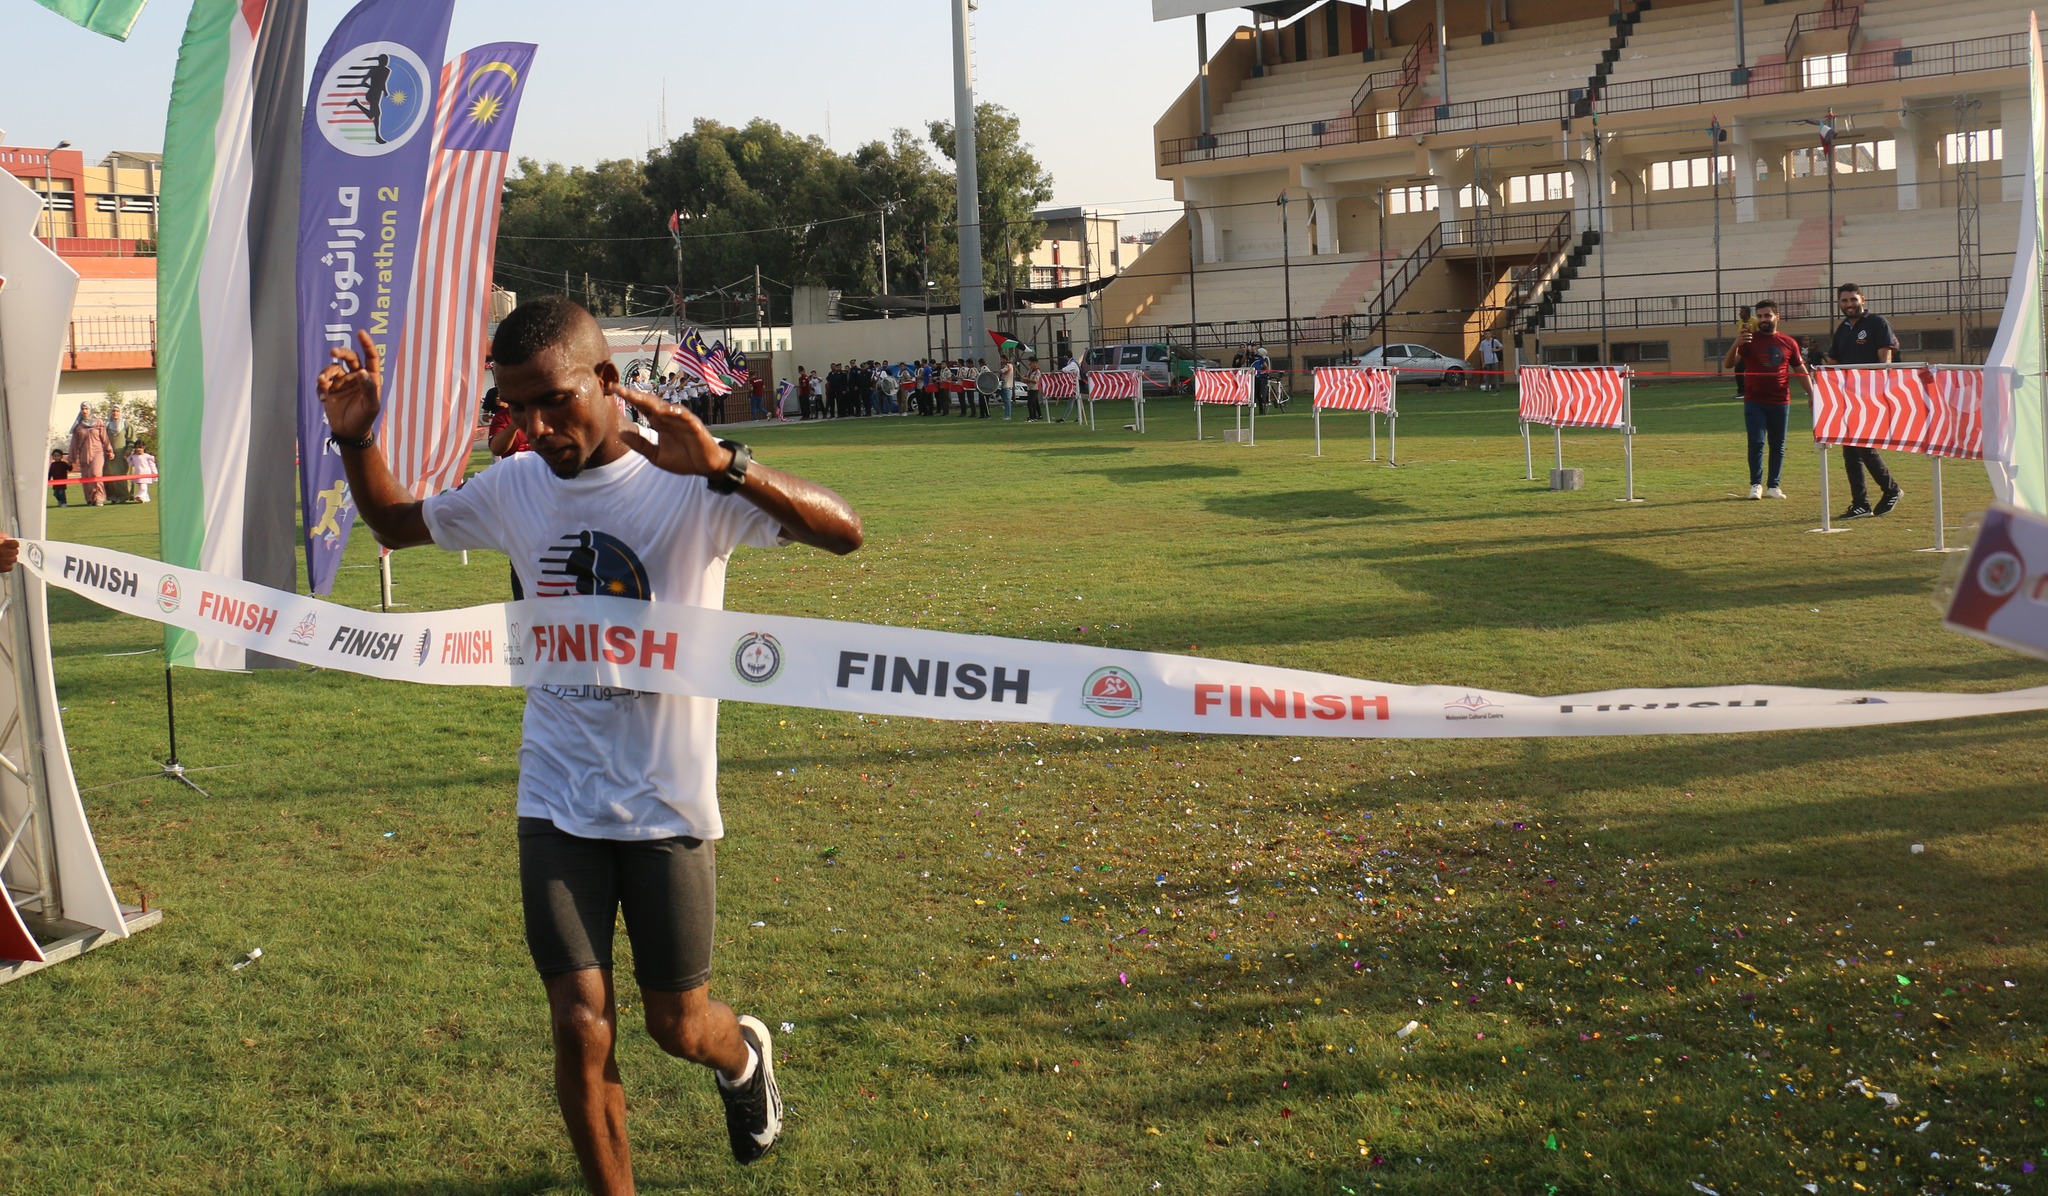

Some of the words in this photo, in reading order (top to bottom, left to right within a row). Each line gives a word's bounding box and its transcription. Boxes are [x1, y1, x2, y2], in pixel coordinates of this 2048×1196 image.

[377, 186, 399, 202] 2
[321, 187, 366, 316] ماراثون
[370, 210, 398, 335] Marathon
[63, 555, 138, 597] FINISH
[199, 591, 278, 635] FINISH
[329, 626, 403, 661] FINISH
[441, 630, 493, 664] FINISH
[532, 624, 679, 670] FINISH
[836, 650, 1030, 704] FINISH
[1194, 683, 1390, 721] FINISH
